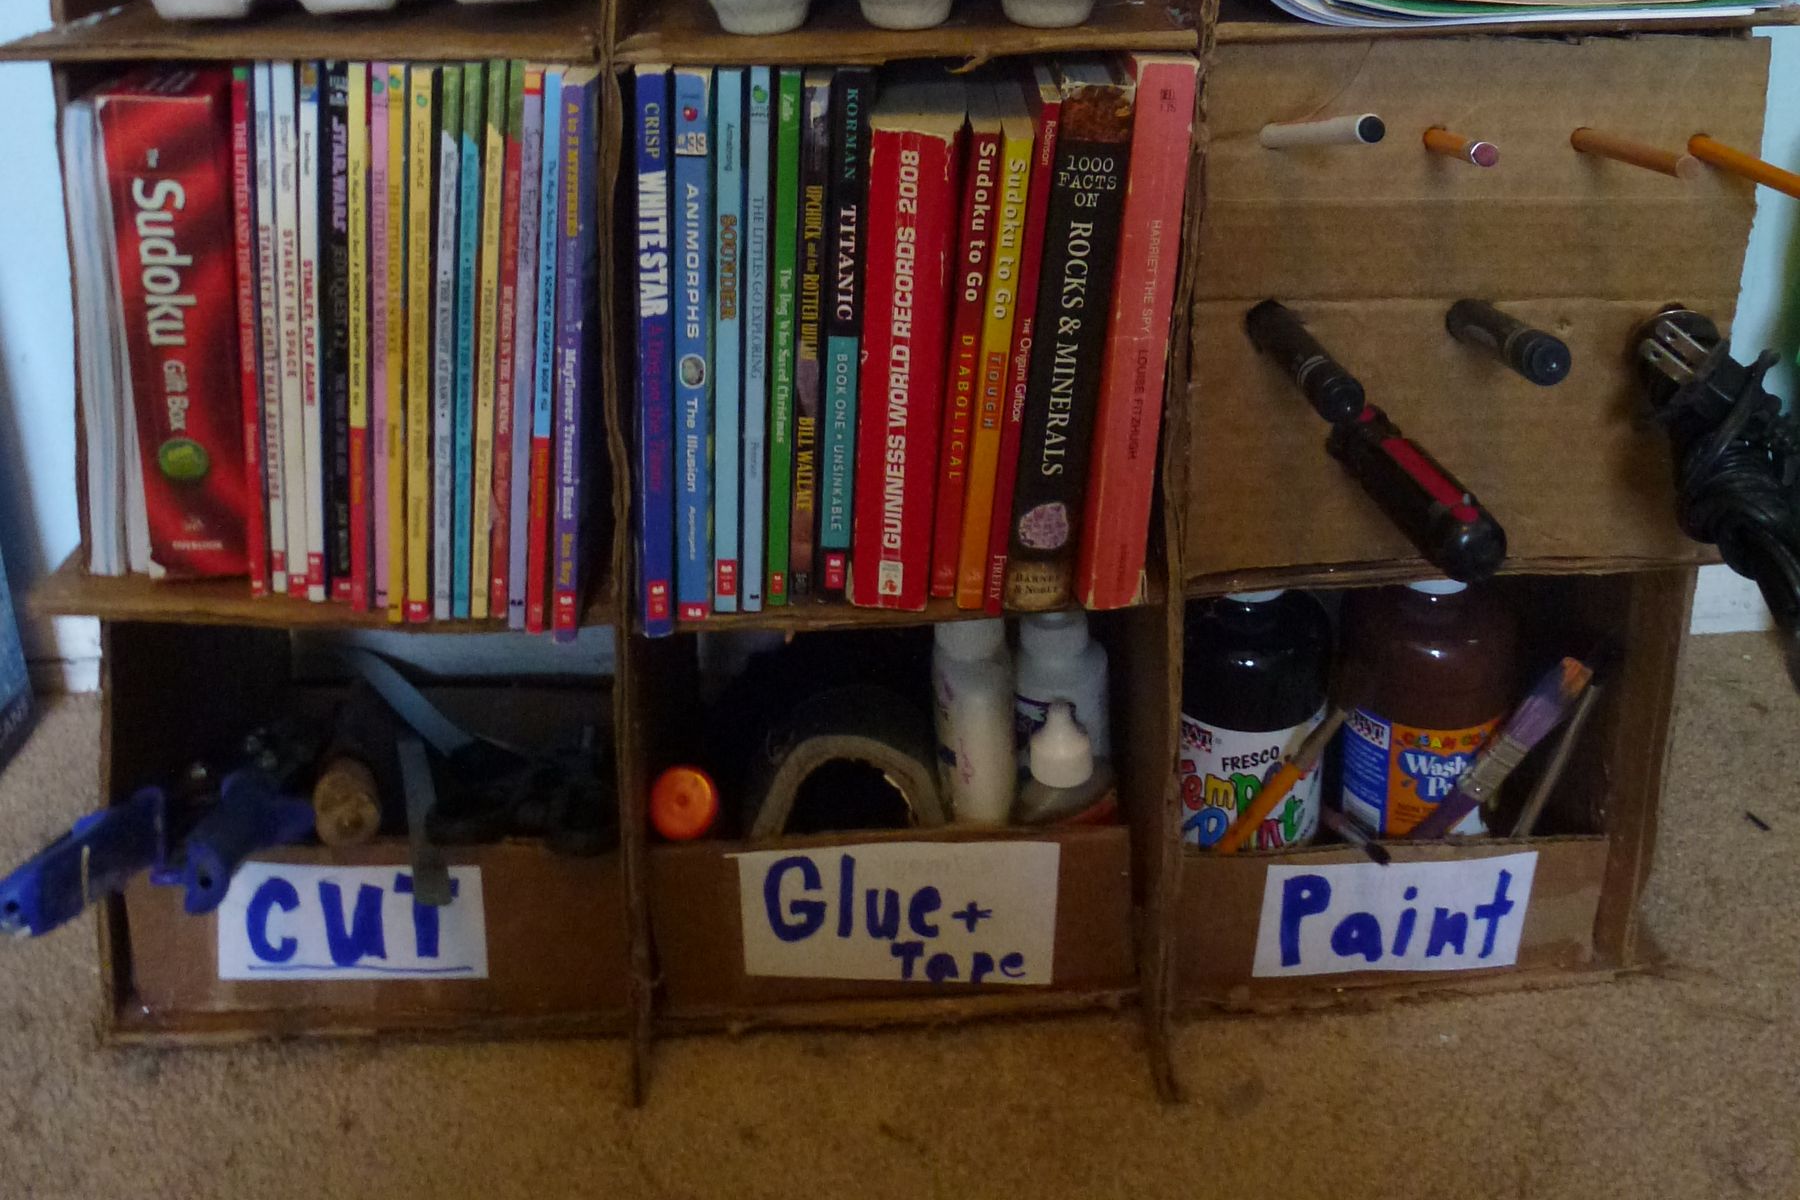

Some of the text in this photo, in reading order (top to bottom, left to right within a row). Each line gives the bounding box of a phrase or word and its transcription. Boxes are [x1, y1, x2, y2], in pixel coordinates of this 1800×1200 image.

[235, 121, 248, 150] THE
[567, 102, 580, 114] A
[567, 118, 579, 132] to
[644, 102, 661, 159] CRISP
[843, 87, 860, 181] KORMAN
[331, 117, 347, 172] STAR
[548, 161, 557, 175] The
[723, 123, 736, 172] Armstrong
[1041, 120, 1057, 167] Robinson
[1066, 155, 1115, 173] 1000
[332, 174, 347, 234] WARS
[373, 170, 385, 197] THE
[389, 184, 400, 209] THE
[545, 180, 556, 205] Magic
[566, 149, 579, 238] MYSTERIES
[804, 185, 824, 240] UPCHUCK
[1058, 172, 1118, 191] FACTS
[1073, 191, 1101, 208] ON
[638, 169, 669, 319] WHITE STAR
[807, 242, 817, 257] and
[964, 141, 996, 303] Sudoku to Go
[993, 159, 1026, 320] Sudoku to Go
[439, 280, 451, 303] THE
[685, 182, 700, 339] ANIMORPHS
[719, 214, 738, 321] SOUNDER
[751, 196, 766, 379] THE LITTLES GO EXPLORING
[807, 258, 818, 273] the
[836, 204, 858, 321] TITANIC
[1140, 220, 1162, 333] HARRIET THE SPY
[132, 177, 197, 346] Sudoku
[166, 395, 190, 431] Box
[282, 230, 297, 378] STANLEY IN SPACE
[543, 275, 553, 316] SCIENCE
[802, 273, 820, 320] ROTTEN
[259, 225, 273, 308] STANLEY'S
[266, 413, 280, 500] ADVENTURE
[439, 358, 450, 374] AT
[500, 358, 512, 380] THE
[775, 268, 792, 444] The Dog Who Saved Christmas
[882, 149, 920, 549] GUINNESS WORLD RECORDS 2008
[1011, 318, 1032, 422] THE Origami Giftbox
[1041, 219, 1094, 477] ROCKS & MINERALS
[948, 335, 975, 480] DIABOLICAL
[983, 355, 1002, 430] TOUGH
[1127, 349, 1148, 460] LOUISE FITZHUGH
[562, 348, 577, 520] Mayflower Treasure Hunt
[685, 397, 699, 493] The Illusion
[795, 416, 815, 512] BILL WALLACE
[829, 353, 849, 531] BOOK ONE UNSINKABLE
[989, 554, 1008, 600] FIREFLY
[1221, 746, 1280, 772] FRESCO
[247, 876, 459, 967] CUT
[1280, 869, 1514, 967] Paint
[891, 941, 1027, 984] Tape
